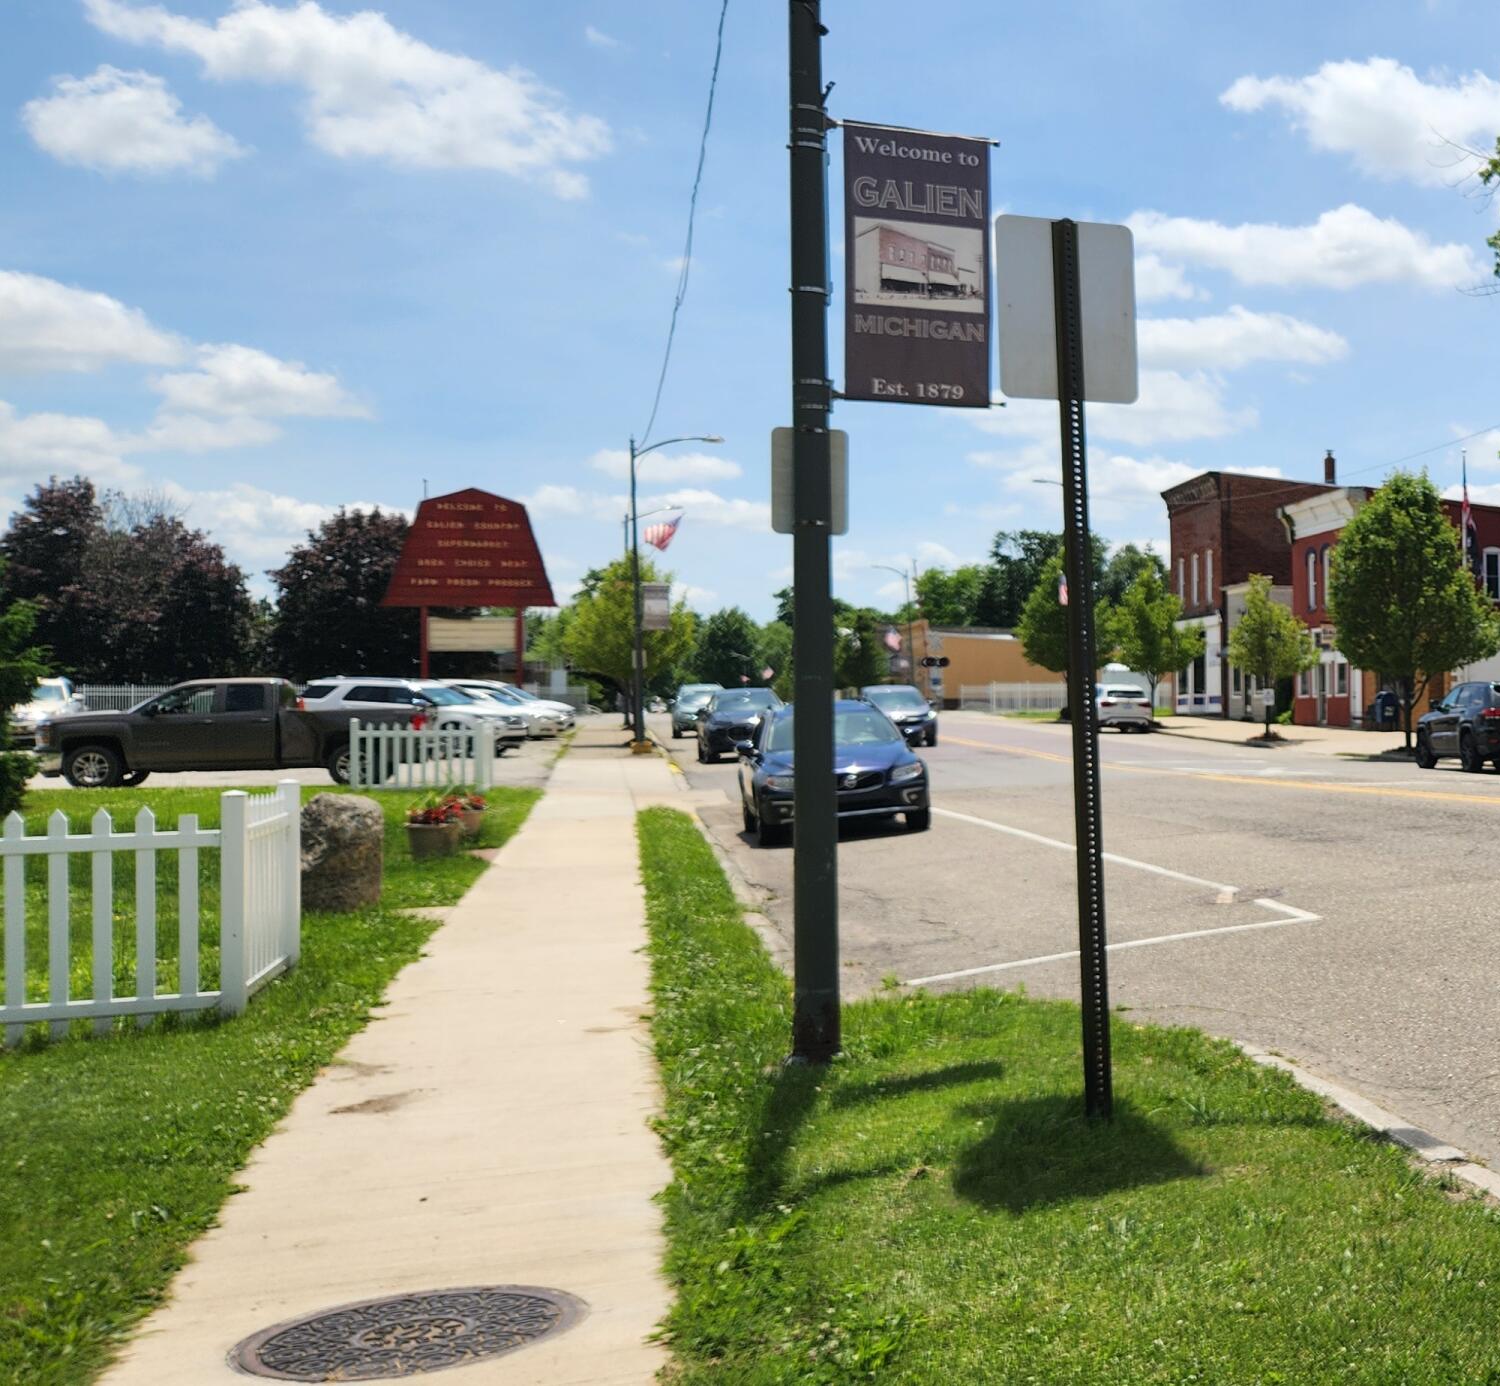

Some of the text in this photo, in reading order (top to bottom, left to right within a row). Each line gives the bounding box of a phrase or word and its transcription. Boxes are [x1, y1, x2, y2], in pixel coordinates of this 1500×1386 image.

[855, 136, 979, 167] Welcome to
[853, 176, 983, 219] GALIEN
[854, 314, 985, 343] MICHIGAN
[872, 377, 965, 400] Est. 1879
[436, 503, 508, 512] WELCOME TO
[410, 578, 438, 586] FARM
